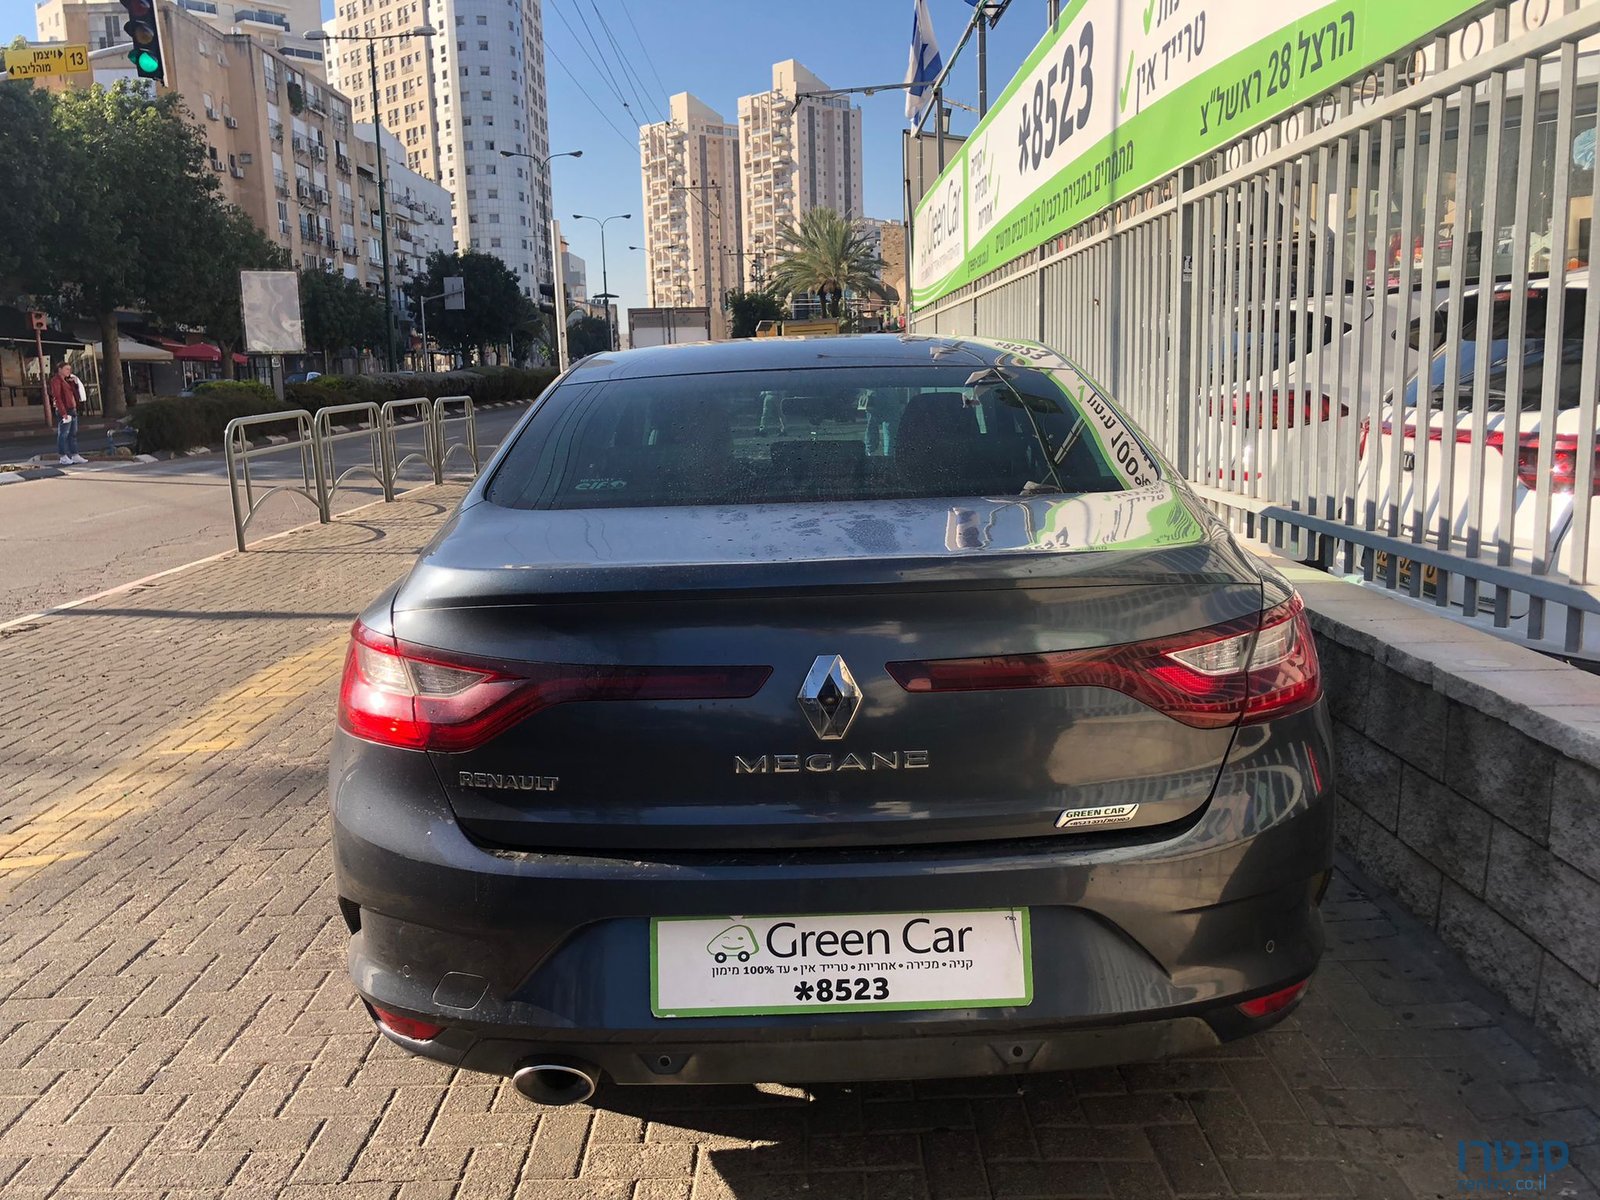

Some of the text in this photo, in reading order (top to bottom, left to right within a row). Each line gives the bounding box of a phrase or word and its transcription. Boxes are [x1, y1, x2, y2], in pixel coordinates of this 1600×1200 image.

[33, 49, 57, 63] ויצמן
[69, 52, 84, 66] 13
[1161, 10, 1206, 81] טרייד
[1298, 10, 1355, 79] הרצל
[16, 63, 52, 75] מוהליבר
[1136, 52, 1157, 115] אין
[1267, 41, 1292, 98] 28
[1094, 139, 1134, 193] מתמחים
[1062, 170, 1092, 214] במכירת
[734, 750, 931, 775] MEGANE
[459, 771, 560, 792] RENAULT
[1065, 807, 1125, 818] GREEN CAR
[766, 918, 973, 959] Green Car
[711, 959, 973, 978] קניה מכירה אחריות טרייד אין עד 100% מימון
